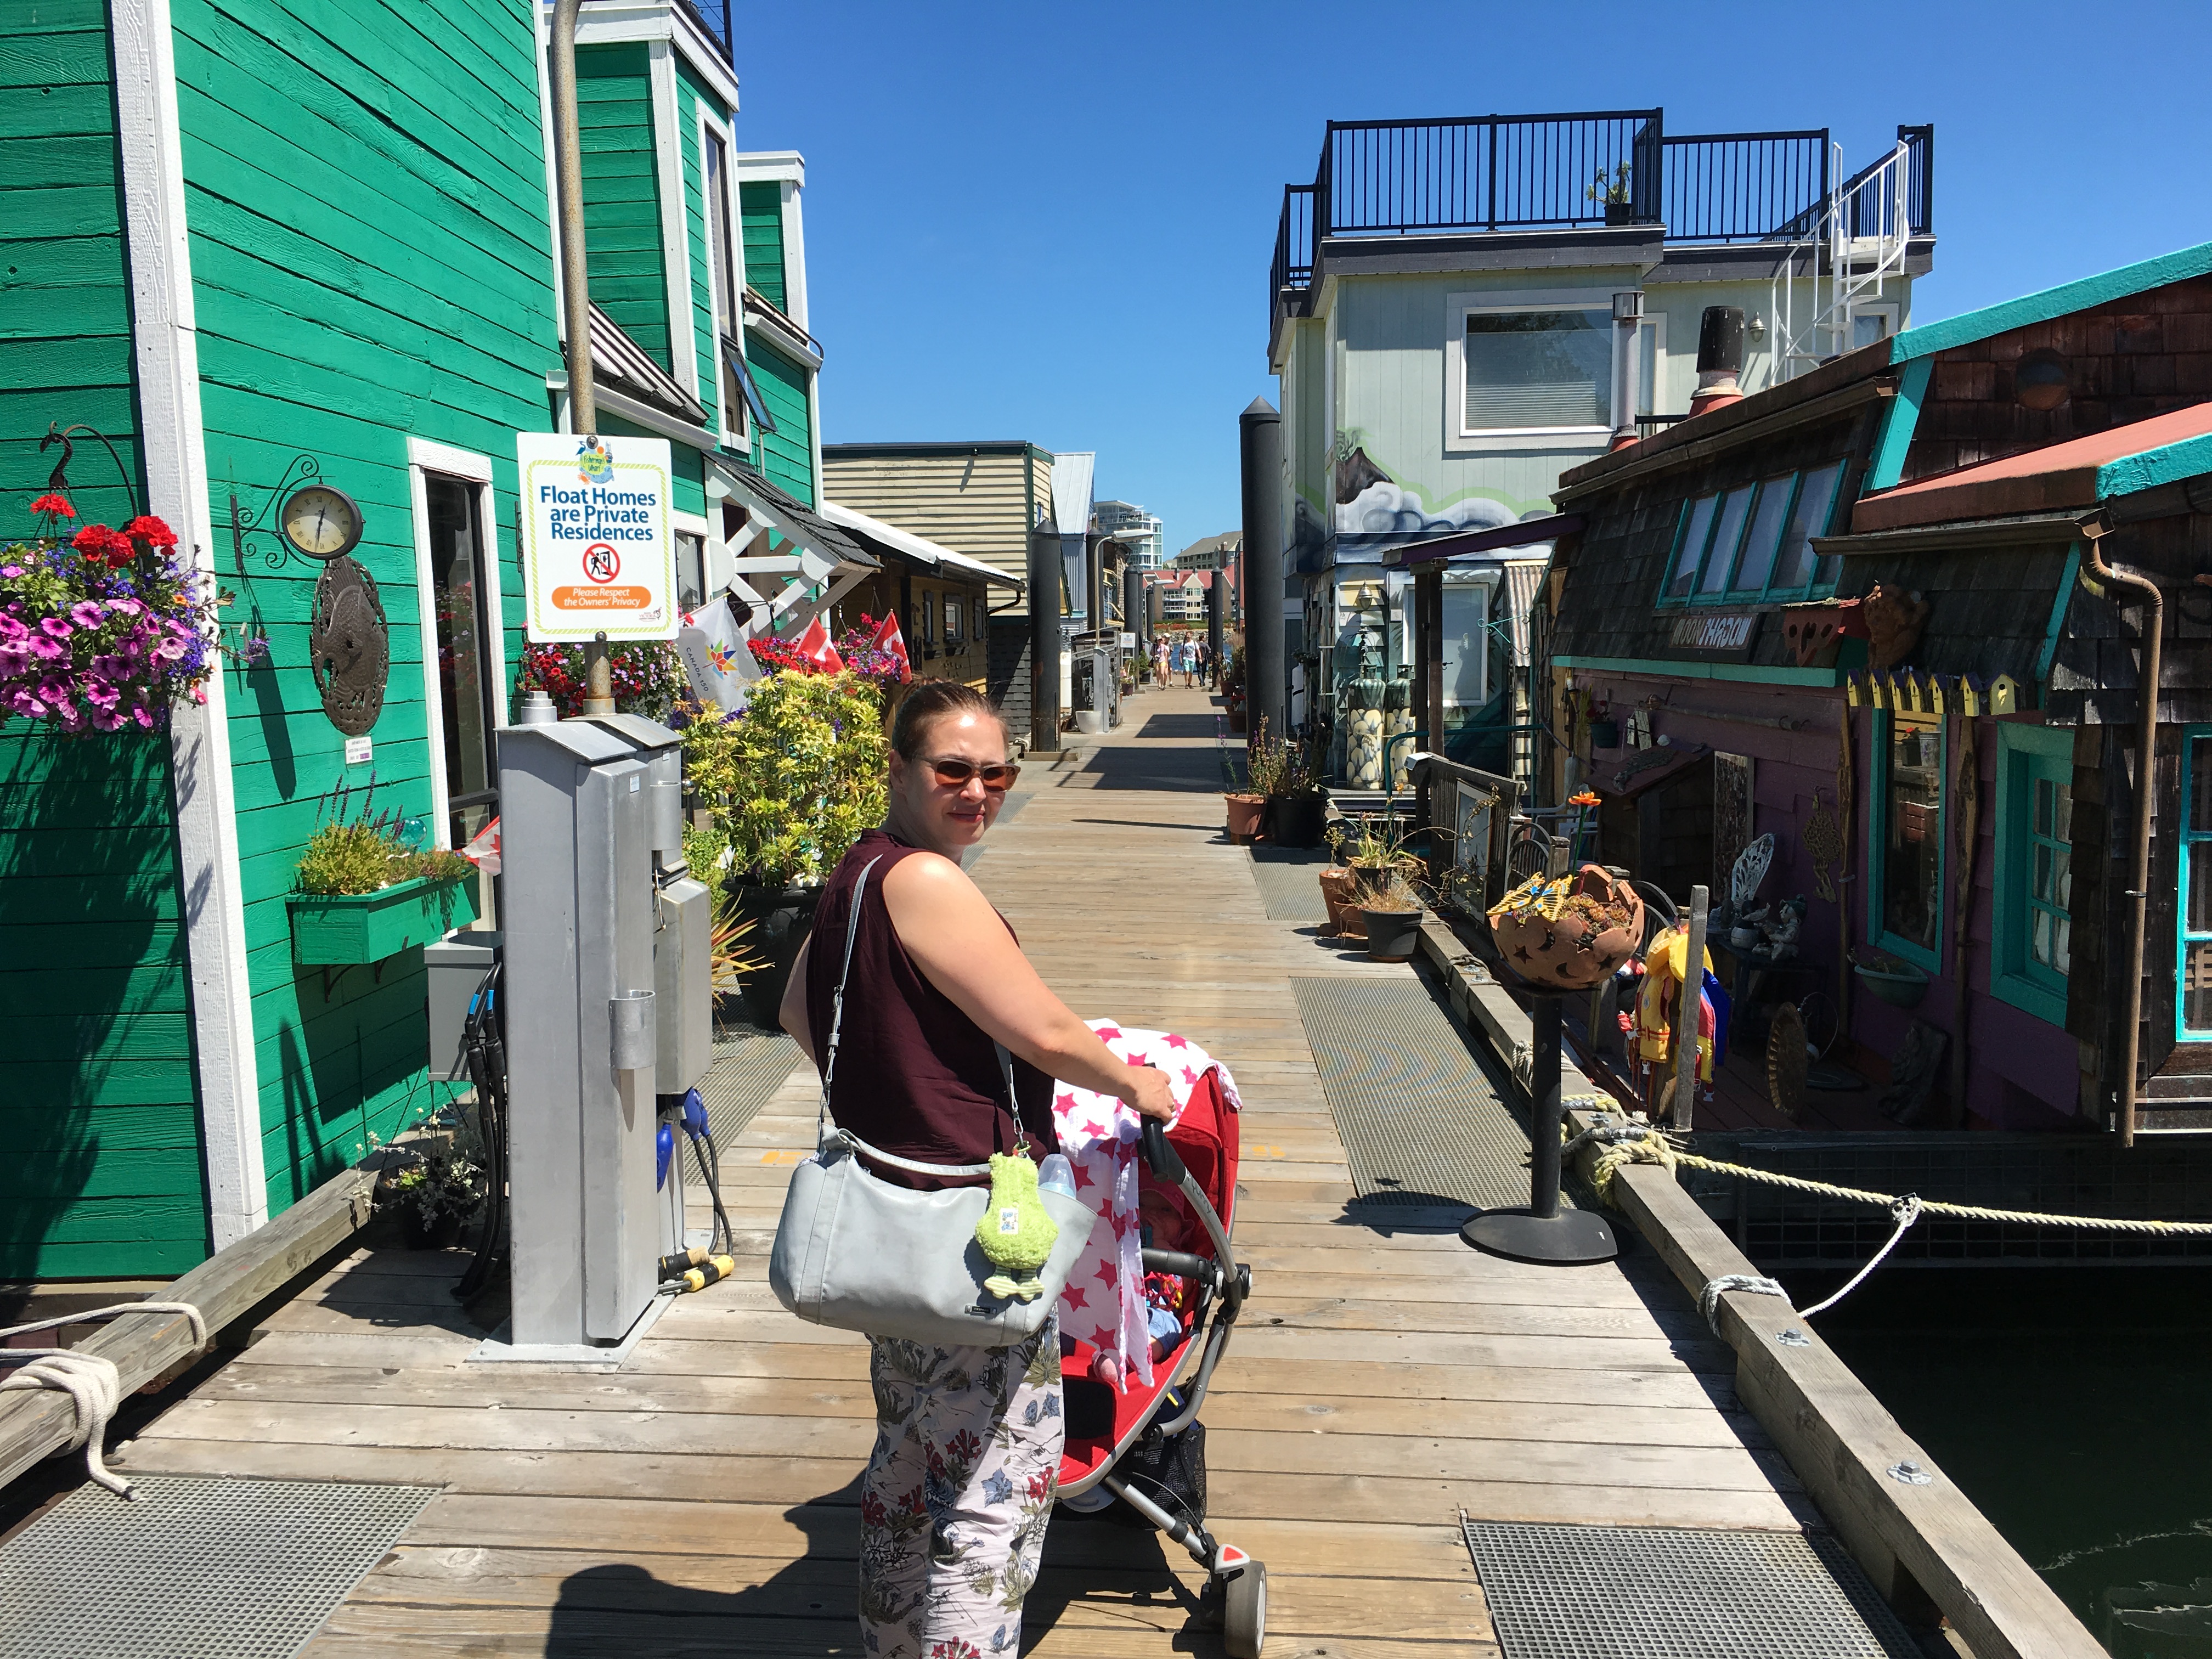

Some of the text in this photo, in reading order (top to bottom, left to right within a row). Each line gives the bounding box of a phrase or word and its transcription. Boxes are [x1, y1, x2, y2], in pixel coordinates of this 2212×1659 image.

[540, 486, 657, 506] Float Homes
[550, 505, 649, 523] are Private
[551, 522, 653, 540] Residences
[564, 597, 578, 606] the
[612, 597, 641, 607] Privacy
[573, 588, 630, 598] Please Respect
[686, 647, 709, 691] CANADA 150
